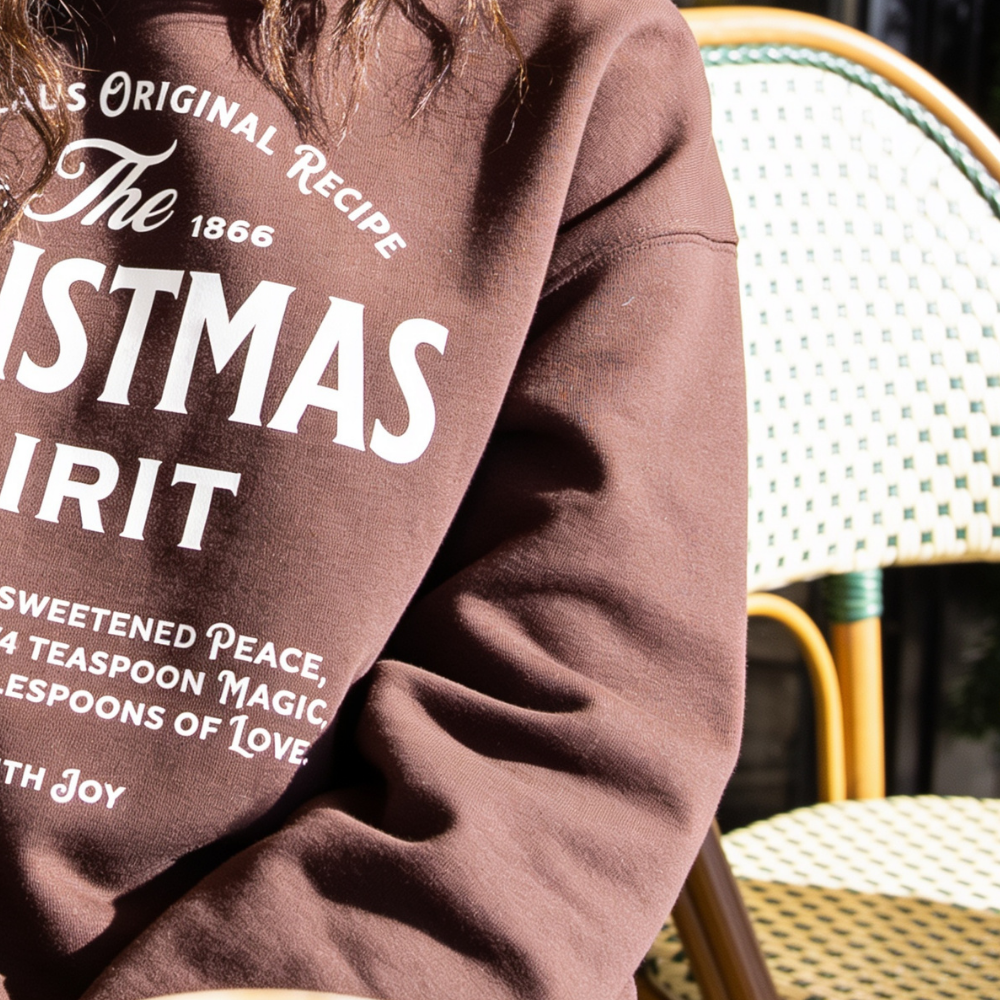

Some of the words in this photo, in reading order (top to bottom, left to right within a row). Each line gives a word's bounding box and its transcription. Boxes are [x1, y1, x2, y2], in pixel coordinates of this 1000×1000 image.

[23, 138, 179, 232] The
[190, 214, 275, 248] 1866
[28, 635, 206, 696] TEASPOON
[174, 711, 223, 741] OF
